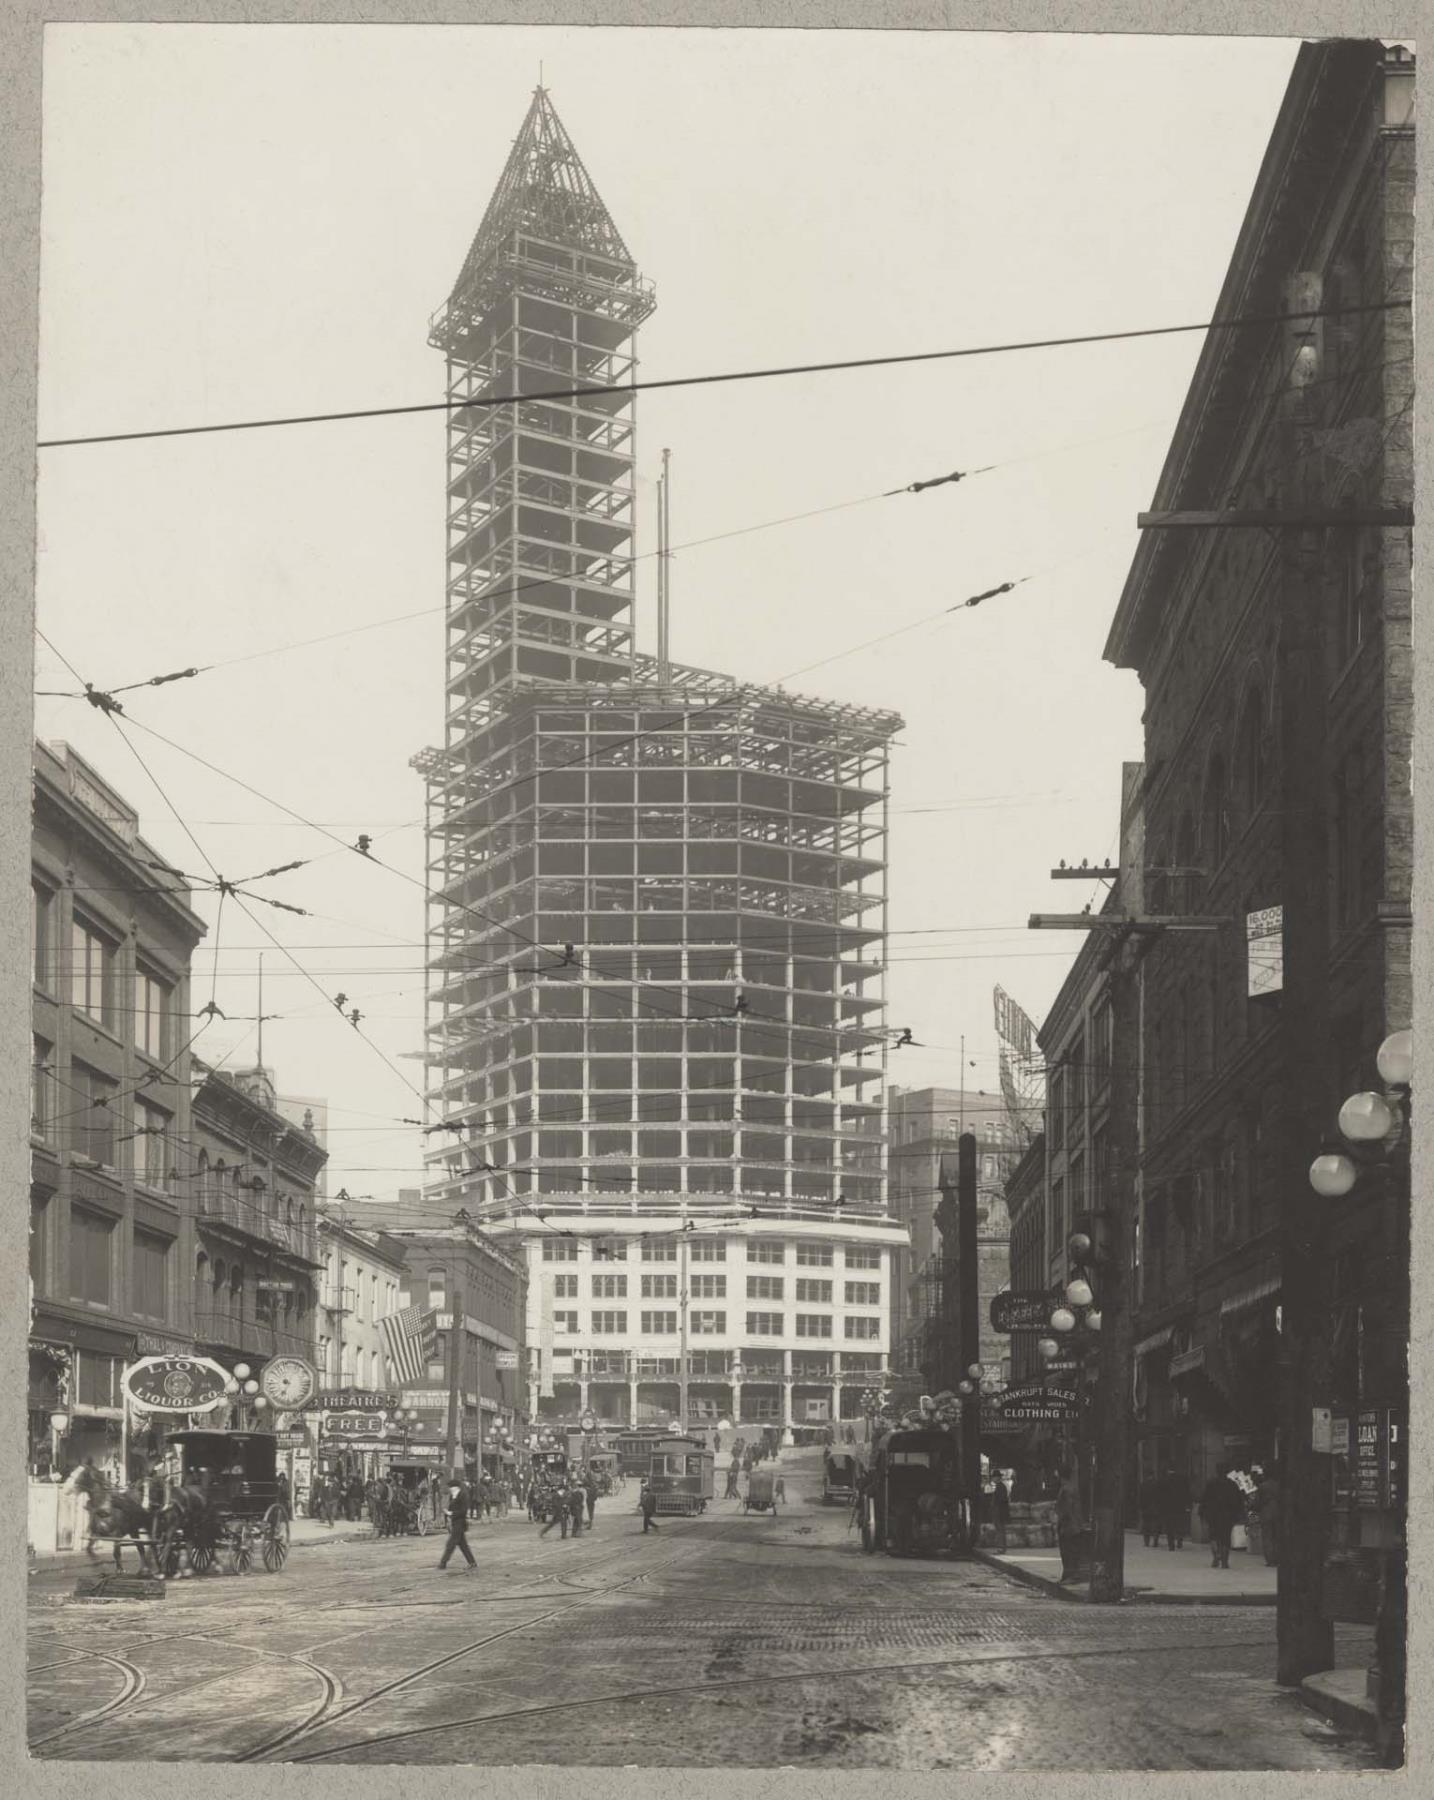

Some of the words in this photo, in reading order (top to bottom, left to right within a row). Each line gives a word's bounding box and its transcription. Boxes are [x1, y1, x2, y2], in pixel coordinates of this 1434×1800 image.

[147, 1361, 209, 1375] LION
[134, 1387, 193, 1407] LIQUOR
[1047, 1387, 1077, 1401] SALES
[322, 1396, 382, 1408] THEATRE
[1004, 1409, 1060, 1418] CLOTHING
[326, 1418, 380, 1431] FREE
[1358, 1424, 1377, 1443] LOAN
